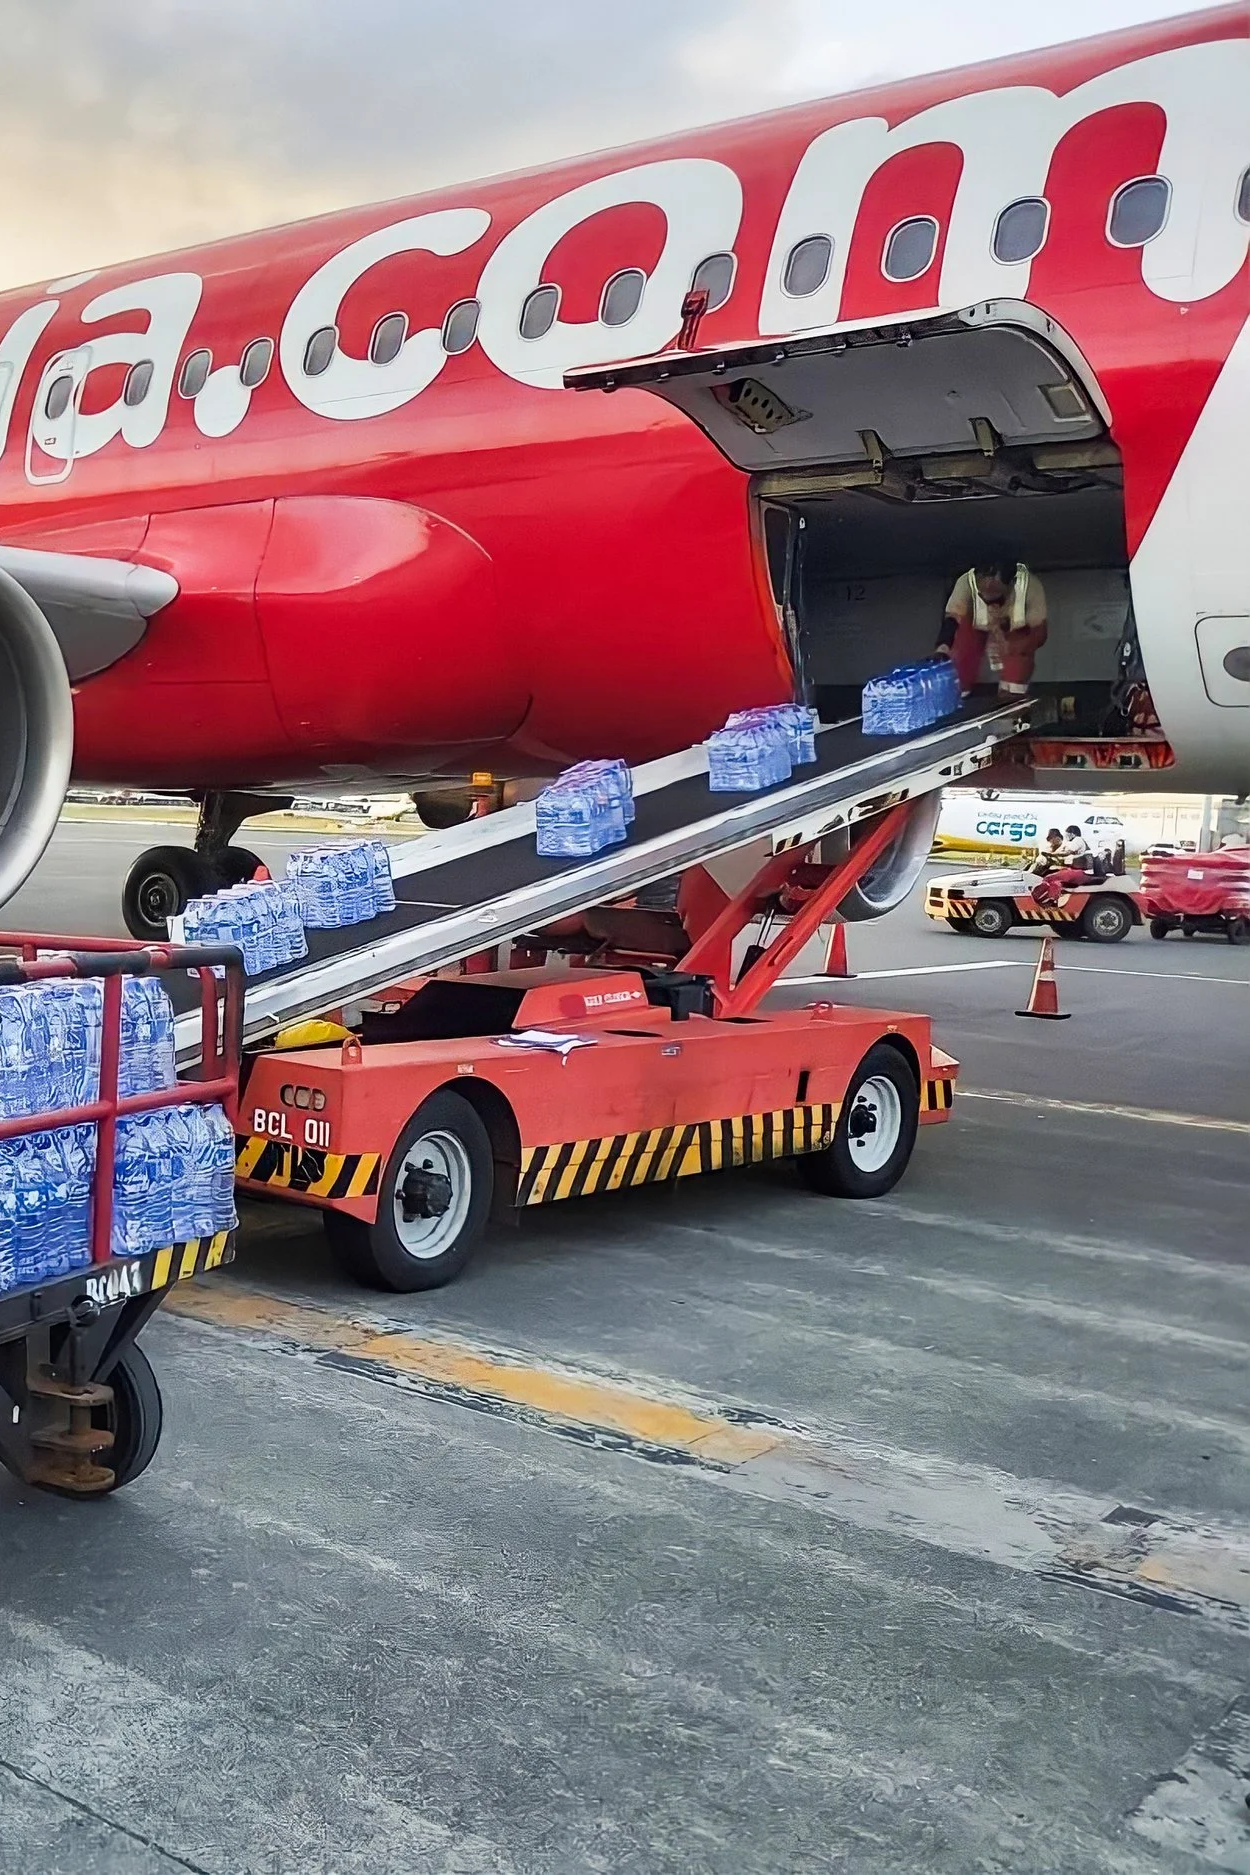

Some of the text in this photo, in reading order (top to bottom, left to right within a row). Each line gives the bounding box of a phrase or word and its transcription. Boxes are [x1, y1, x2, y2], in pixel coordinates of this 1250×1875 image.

[976, 821, 1037, 842] cargo
[254, 1108, 330, 1147] BCL 011
